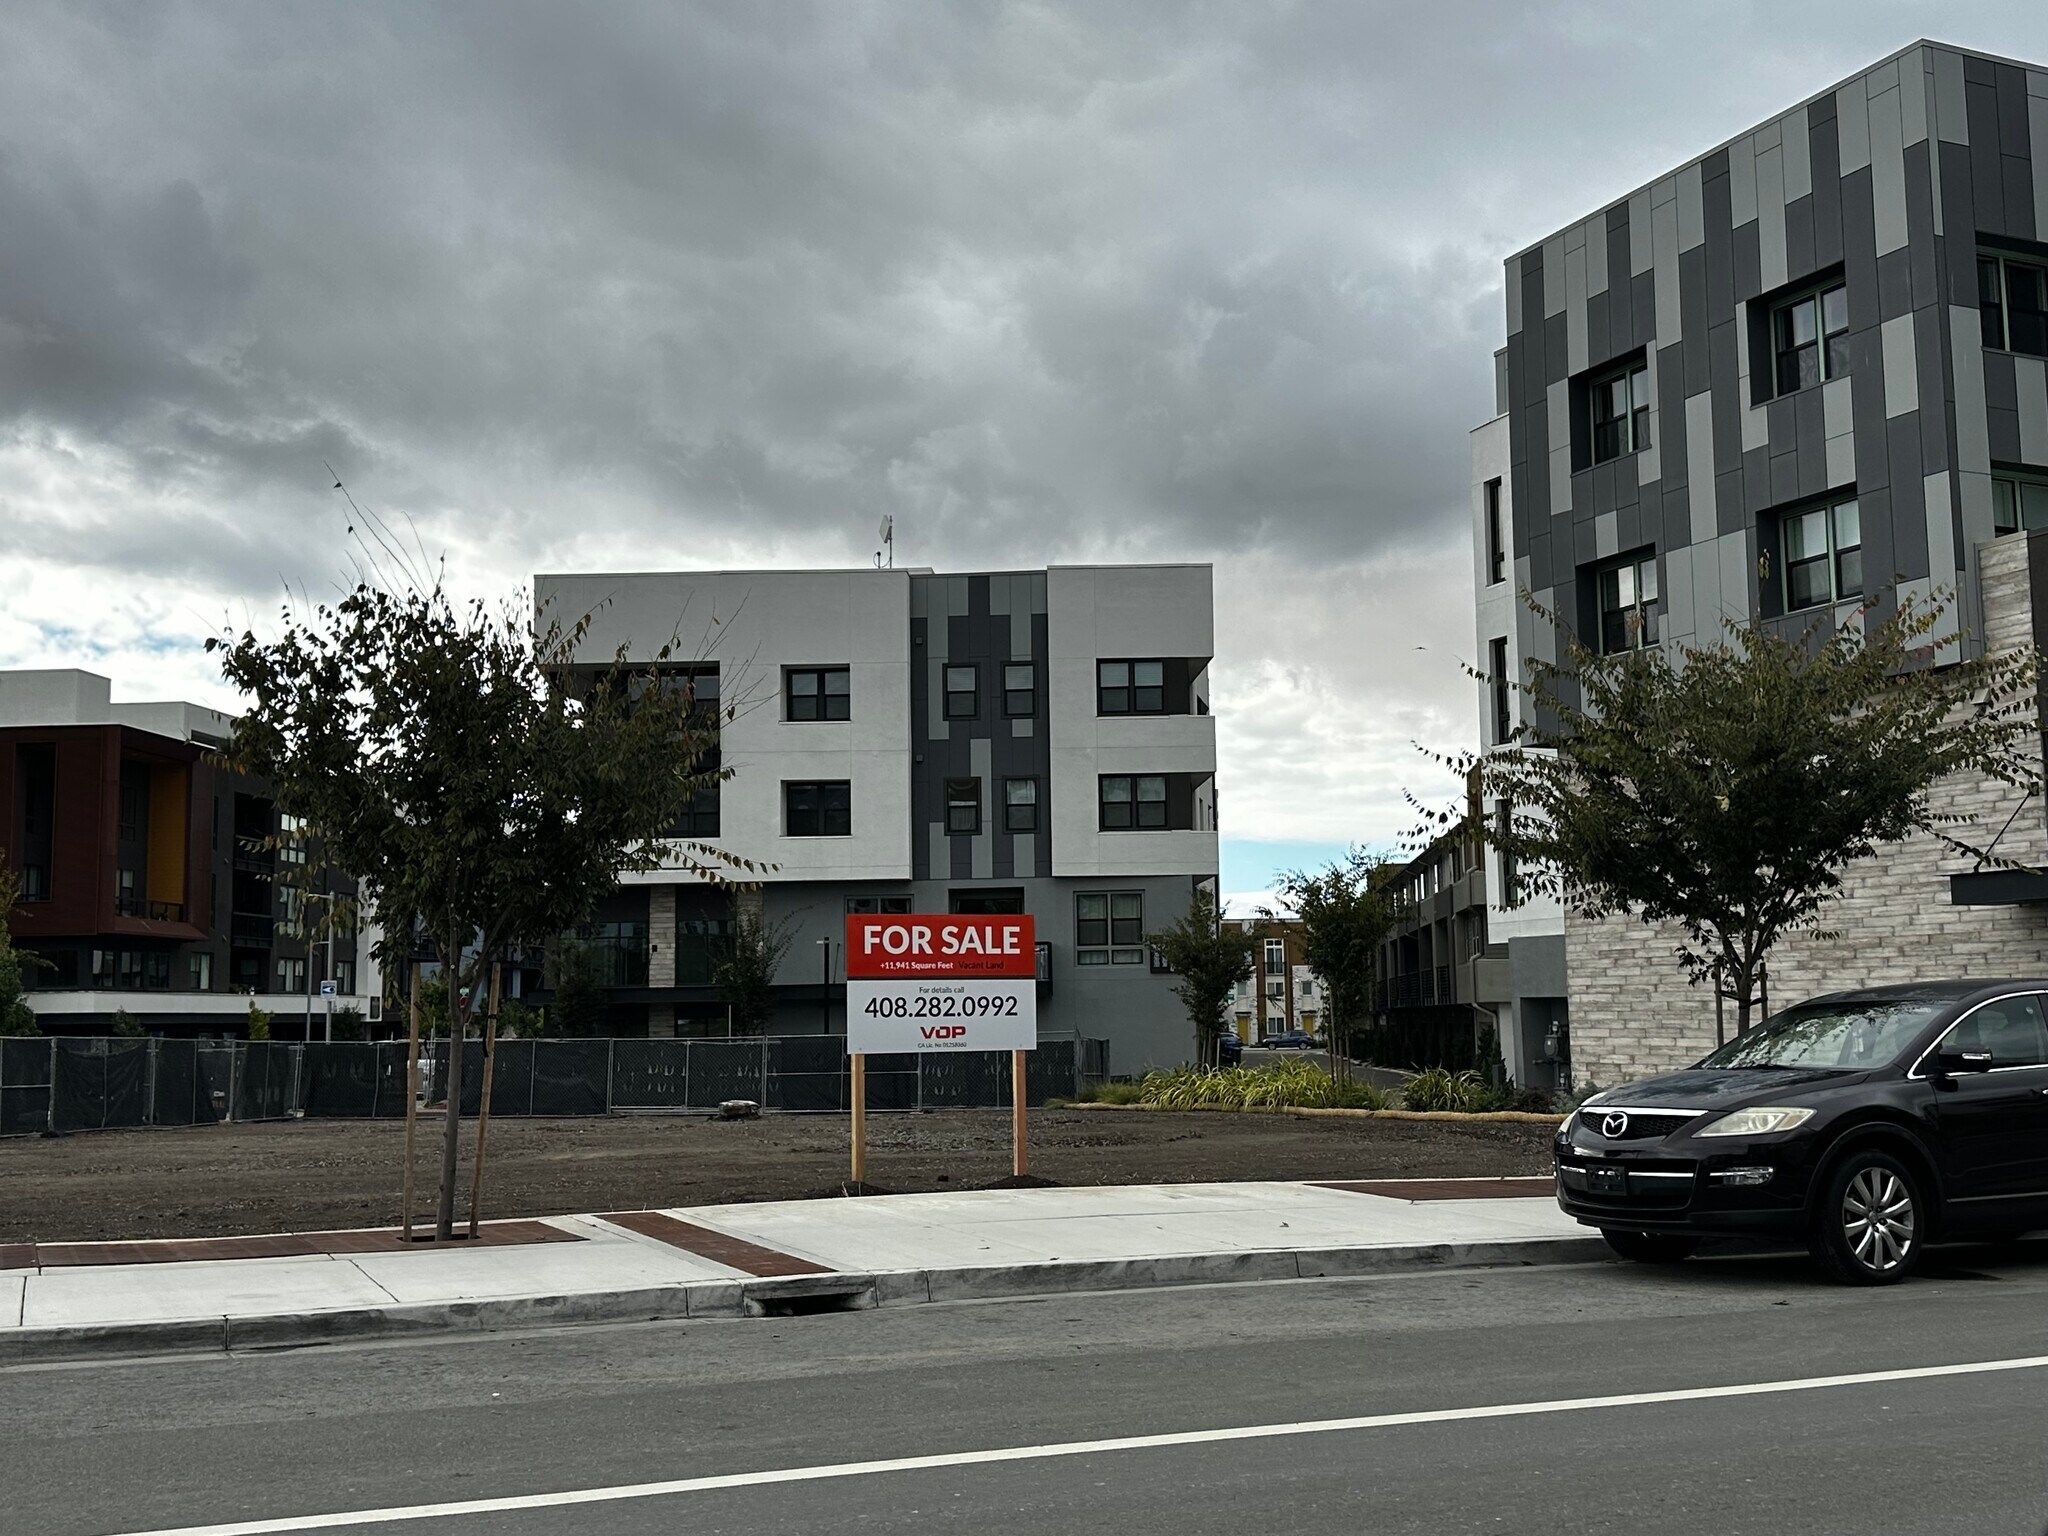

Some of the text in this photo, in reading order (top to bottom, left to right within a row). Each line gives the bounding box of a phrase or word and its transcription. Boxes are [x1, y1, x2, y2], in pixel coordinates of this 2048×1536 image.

[864, 925, 1021, 955] FOR SALE
[880, 961, 1004, 970] +11,941 Square Feet Vacant Land
[864, 996, 1018, 1018] 408.282.0992
[920, 1026, 966, 1039] VOP
